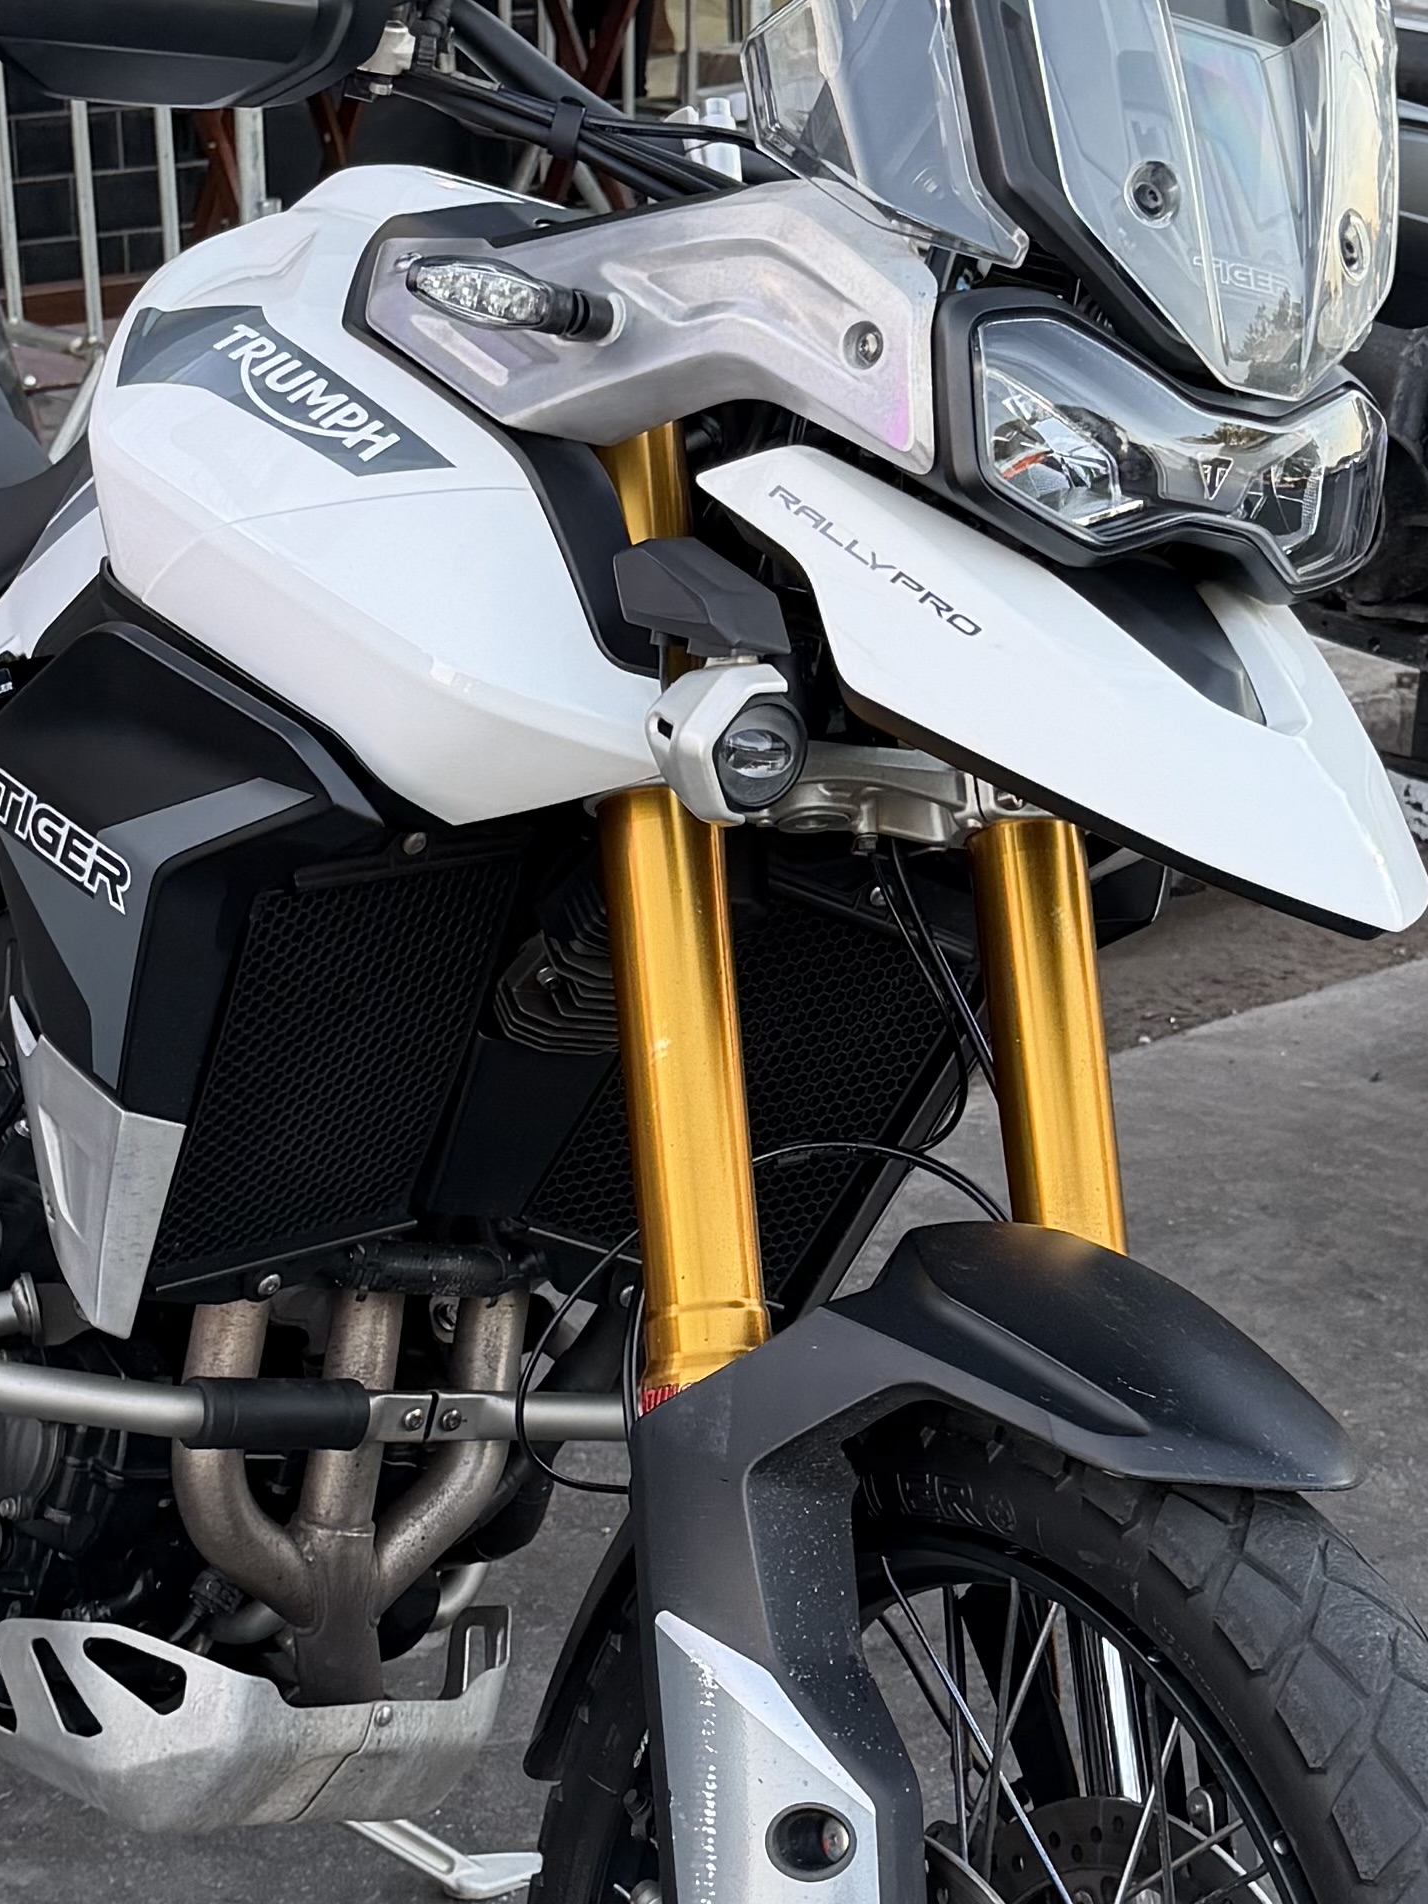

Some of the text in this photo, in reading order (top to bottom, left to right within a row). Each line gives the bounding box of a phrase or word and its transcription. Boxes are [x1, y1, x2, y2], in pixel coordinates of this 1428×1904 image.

[1192, 255, 1292, 297] TIGER
[212, 324, 401, 462] TRIUMPH
[768, 485, 983, 637] RALLY PRO
